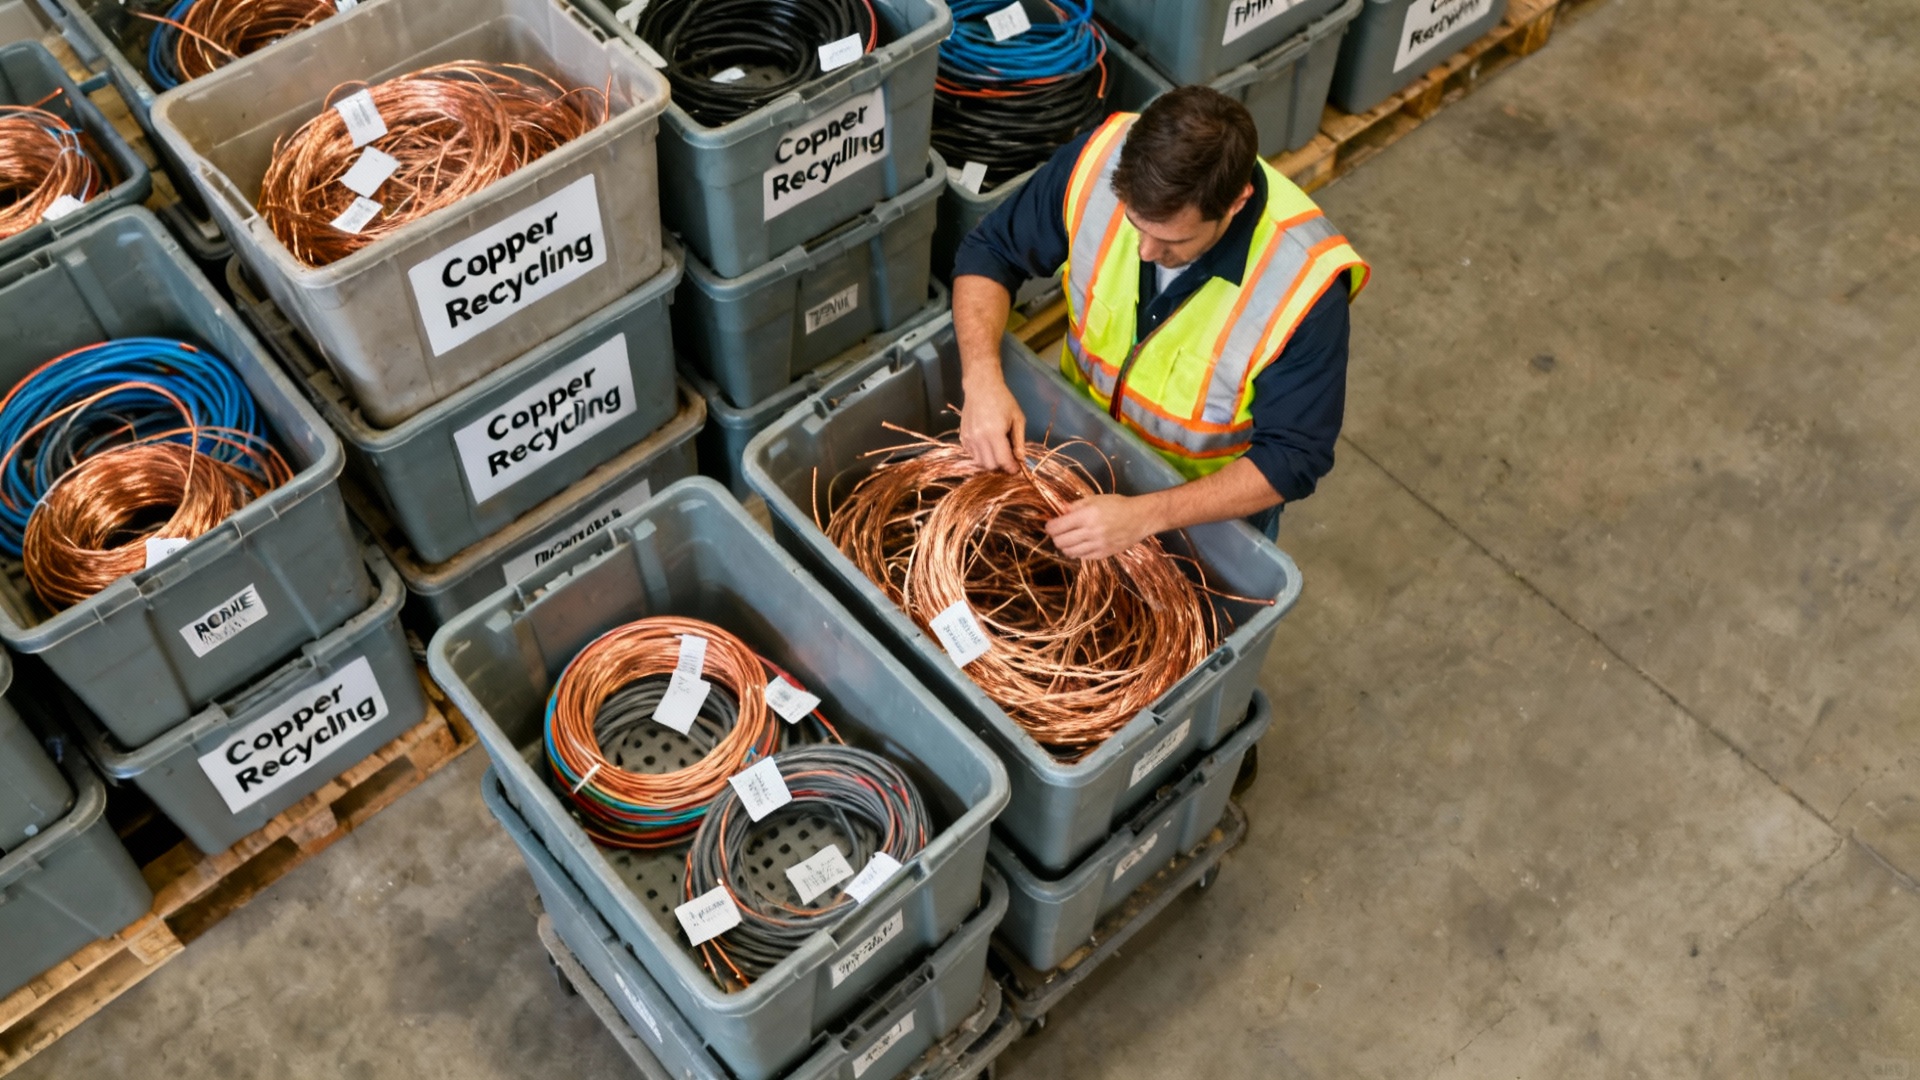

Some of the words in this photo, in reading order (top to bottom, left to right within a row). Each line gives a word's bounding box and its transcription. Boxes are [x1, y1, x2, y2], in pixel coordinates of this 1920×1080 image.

[442, 211, 558, 288] Copper
[445, 233, 593, 328] Recycling
[487, 367, 596, 441] Copper
[226, 684, 343, 765] Copper
